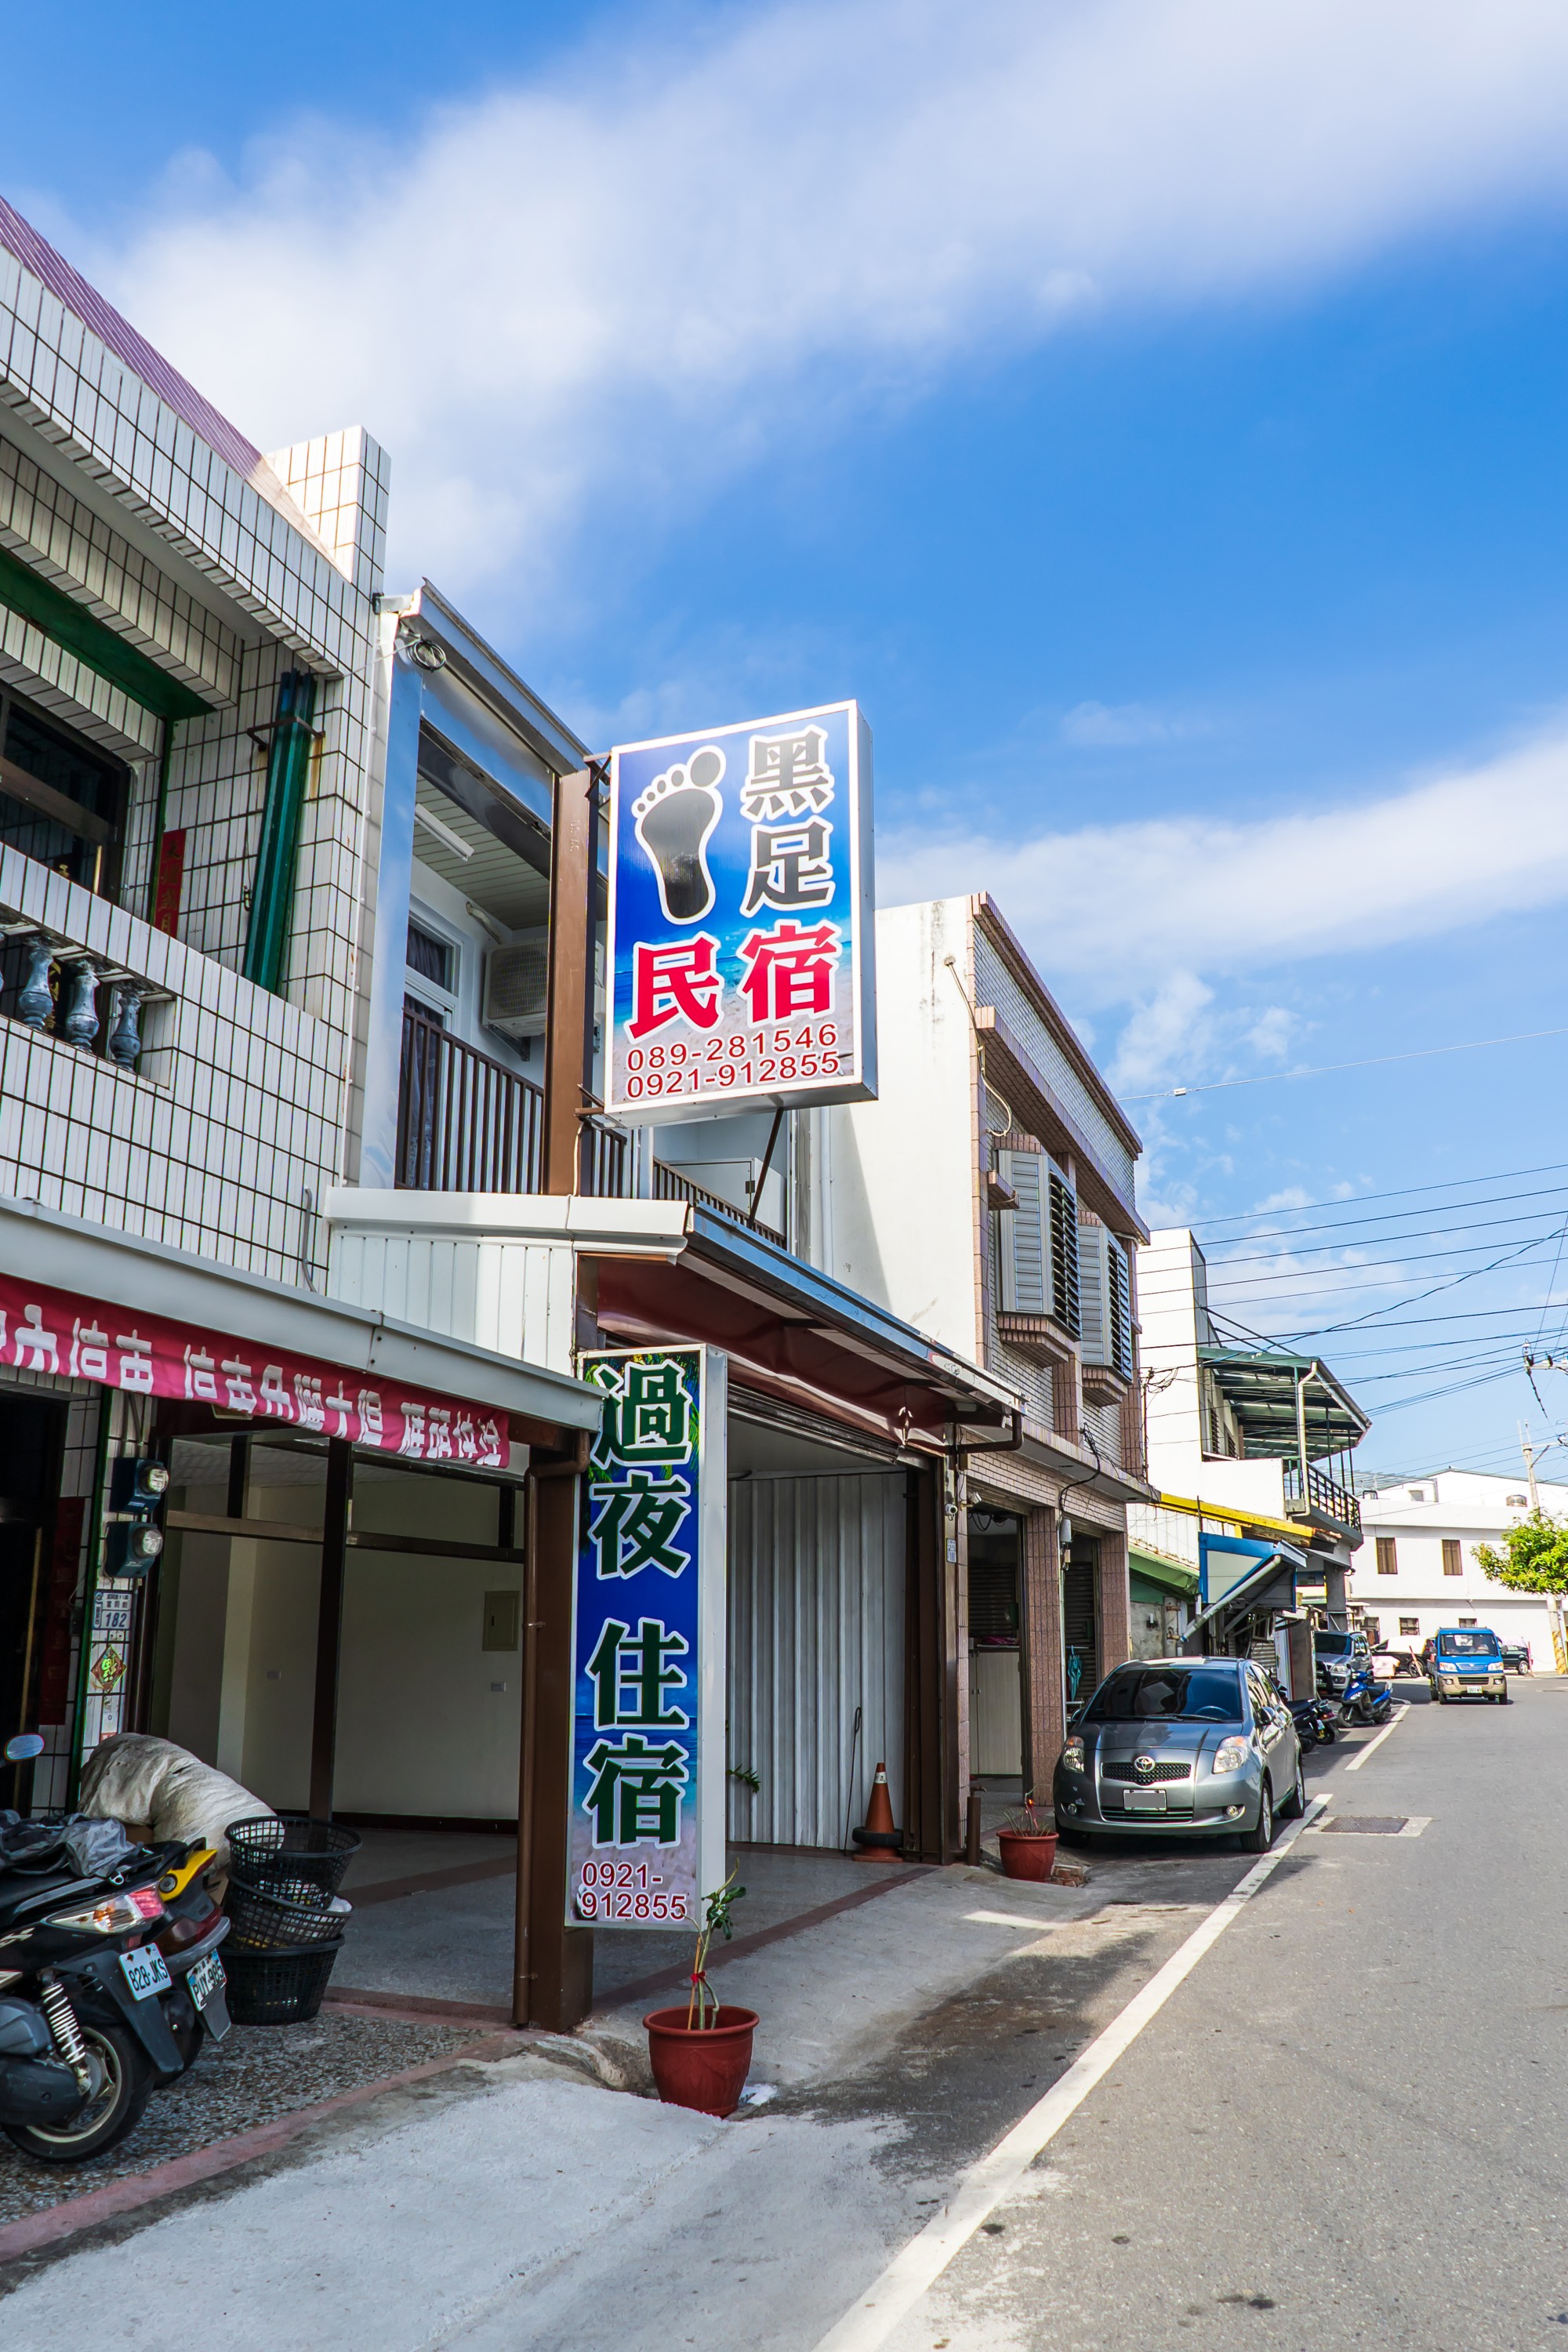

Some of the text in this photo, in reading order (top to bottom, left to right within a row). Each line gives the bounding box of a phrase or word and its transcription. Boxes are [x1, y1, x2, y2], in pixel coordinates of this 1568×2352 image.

[743, 729, 833, 914] 黑足
[628, 924, 839, 1044] 民宿
[627, 1023, 838, 1073] 089-281546
[626, 1051, 840, 1098] 0921-912855
[105, 1611, 127, 1628] 182
[586, 1620, 689, 1847] 住宿
[583, 1862, 662, 1889] 0921-
[582, 1891, 686, 1919] 912855
[128, 1958, 169, 1992] 828-JKS
[191, 1958, 225, 2005] PUY-985
